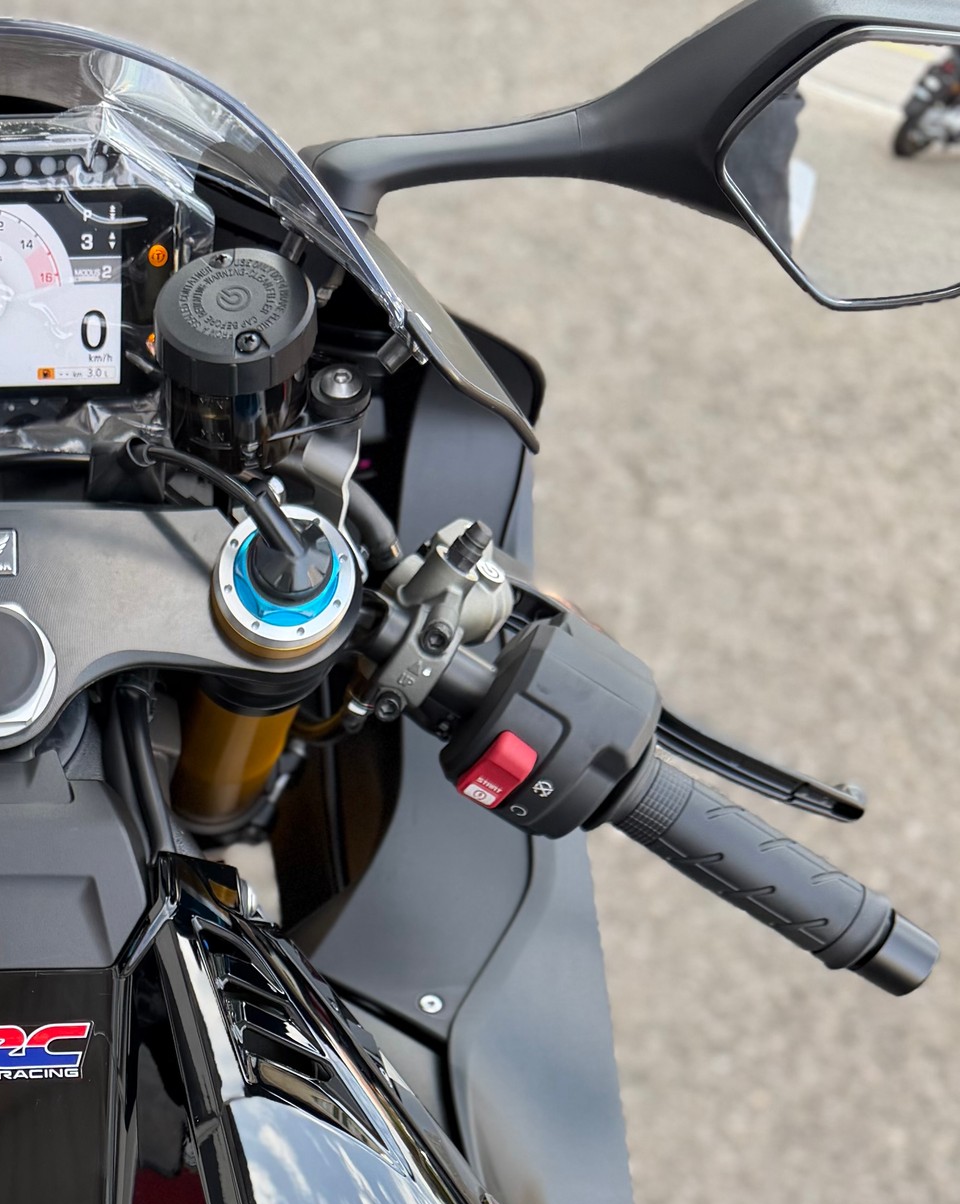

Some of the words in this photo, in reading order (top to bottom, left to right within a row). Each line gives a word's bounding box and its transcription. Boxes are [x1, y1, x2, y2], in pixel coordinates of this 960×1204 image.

[20, 239, 33, 250] 14
[81, 233, 93, 250] 3
[40, 272, 53, 283] 16
[101, 264, 113, 279] 2
[81, 309, 107, 352] 0
[88, 353, 113, 363] km/h
[87, 368, 102, 378] 3.0
[476, 777, 503, 794] START
